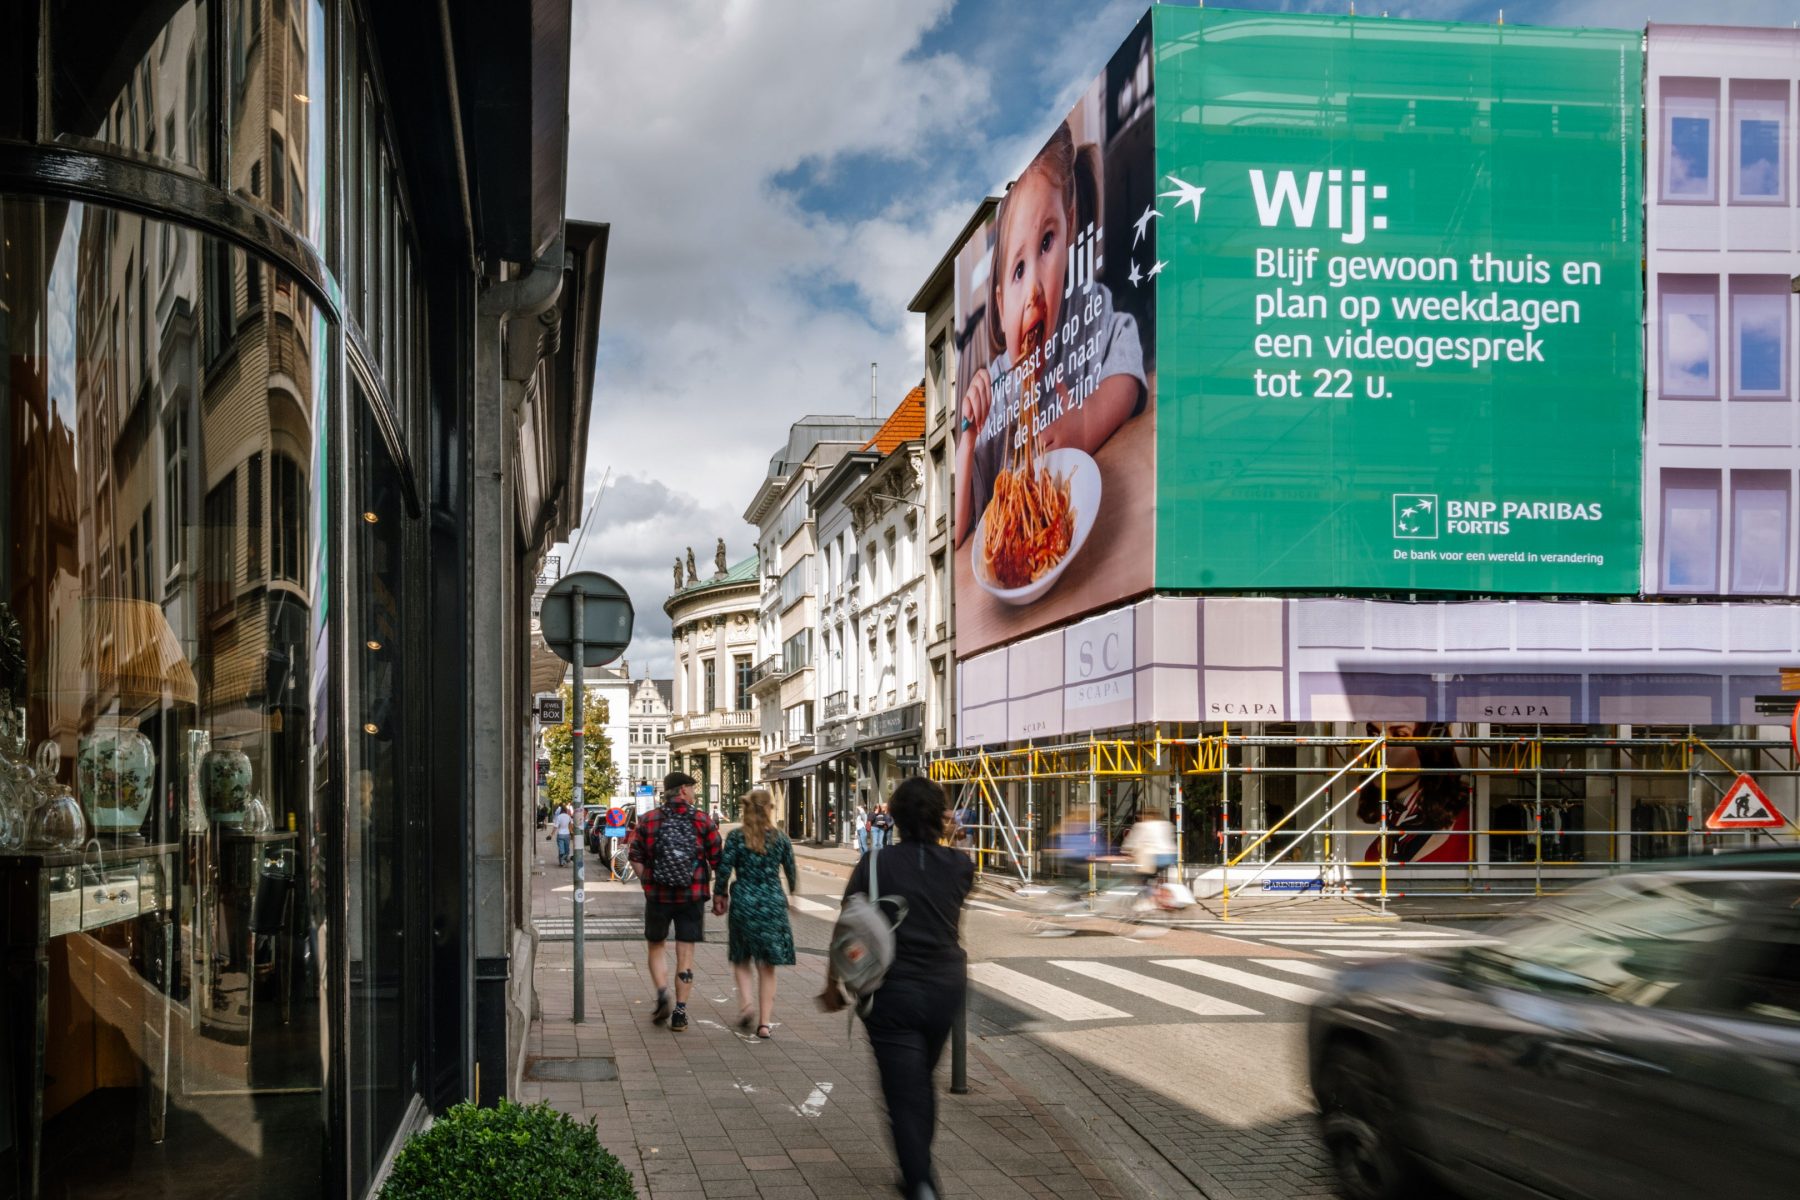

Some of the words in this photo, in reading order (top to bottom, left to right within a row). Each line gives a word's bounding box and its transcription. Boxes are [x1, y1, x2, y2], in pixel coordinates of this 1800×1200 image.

[1249, 168, 1388, 245] Wij:
[1255, 248, 1320, 286] Blijf
[1328, 253, 1458, 287] gewoon
[1469, 252, 1551, 285] thuis
[1562, 261, 1601, 285] en
[1255, 288, 1328, 326] plan
[1339, 294, 1381, 333] op
[1391, 291, 1581, 331] weekdagen
[1015, 347, 1041, 392] past
[1044, 332, 1058, 360] er
[1062, 314, 1079, 345] op
[1084, 294, 1102, 326] de
[1254, 333, 1312, 359] een
[1323, 329, 1545, 368] videogesprek
[987, 400, 1020, 440] kleine
[1023, 378, 1041, 411] als
[1044, 362, 1064, 393] we
[1068, 330, 1102, 375] naar
[1253, 368, 1303, 398] tot
[1312, 368, 1354, 399] 22
[1366, 375, 1394, 399] u.
[1014, 424, 1028, 449] de
[1032, 392, 1064, 437] bank
[1068, 362, 1102, 410] zijn?
[1447, 501, 1497, 519] BNP
[1503, 502, 1602, 521] PARIBAS
[1447, 520, 1510, 535] FORTIS
[1393, 550, 1408, 560] De
[1410, 550, 1437, 560] bank
[1440, 552, 1463, 561] voor
[1466, 553, 1485, 561] een
[1488, 552, 1525, 562] wereld
[1528, 553, 1537, 562] in
[1540, 553, 1604, 565] verandering
[1079, 681, 1119, 700] SCAPA
[543, 710, 560, 719] BOX
[1211, 702, 1278, 716] SCAPA
[1484, 704, 1550, 718] SCAPA
